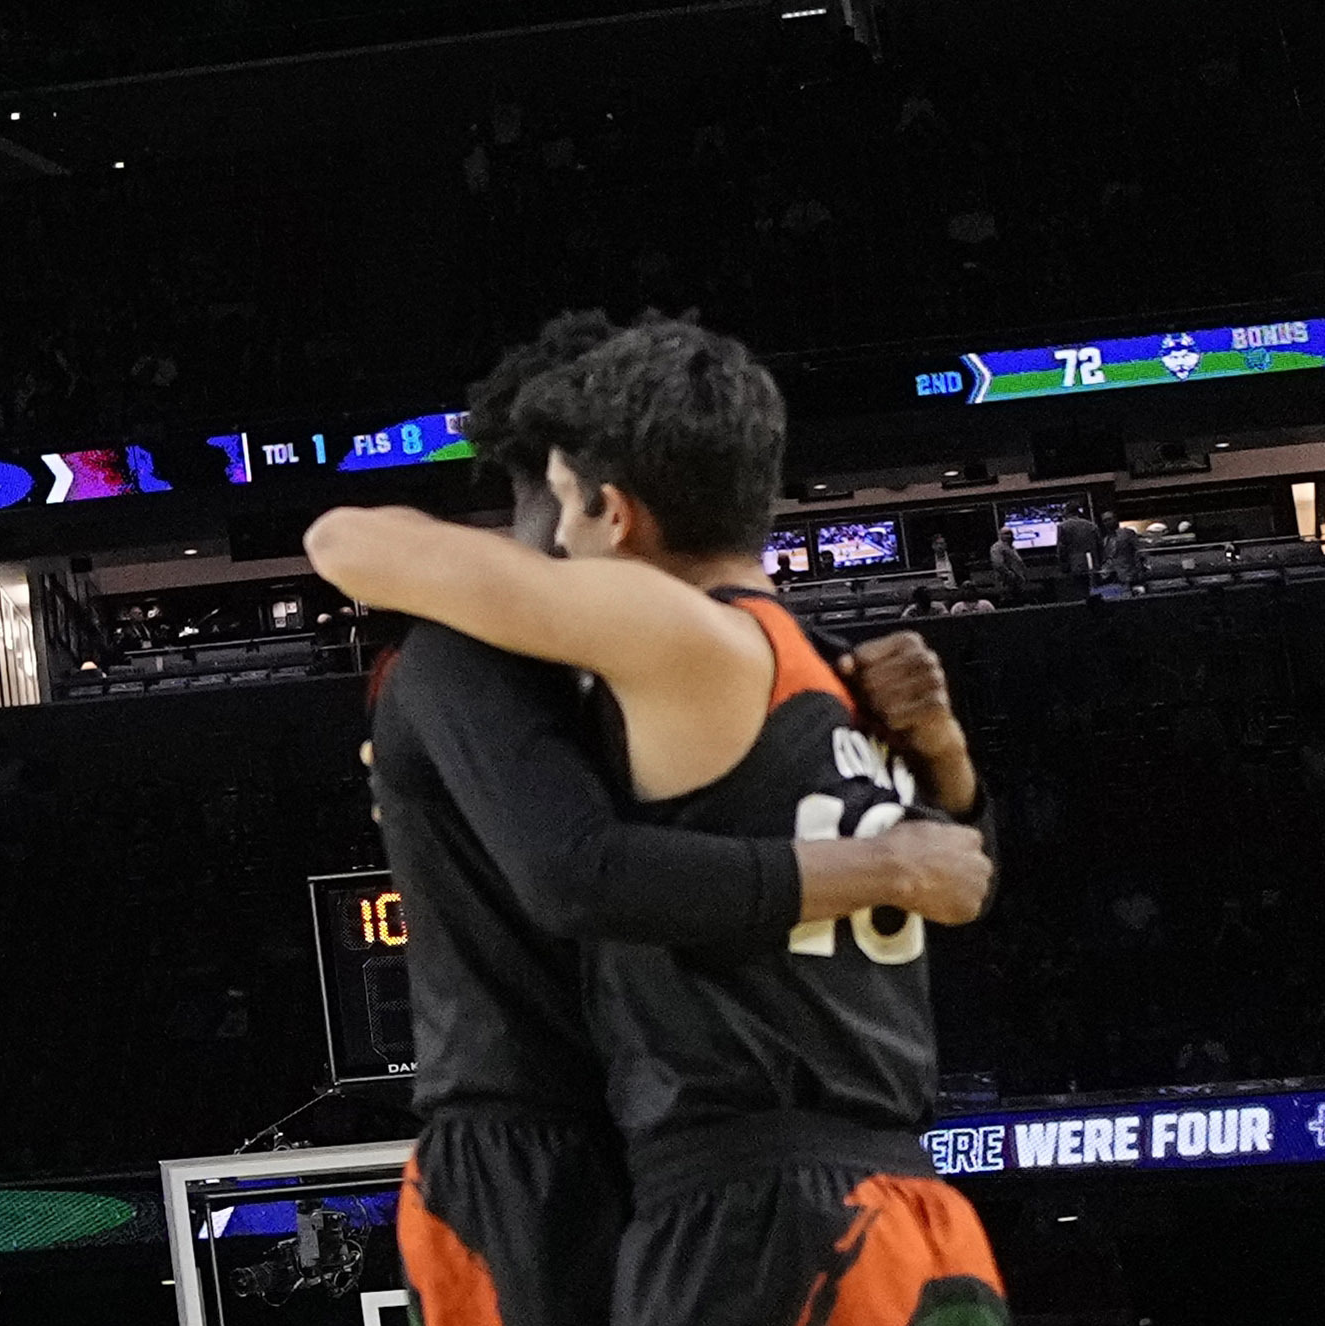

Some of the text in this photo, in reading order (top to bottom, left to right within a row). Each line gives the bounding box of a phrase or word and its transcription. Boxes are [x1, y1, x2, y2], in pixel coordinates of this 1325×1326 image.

[1231, 321, 1309, 350] BONUS
[1054, 347, 1106, 387] 72
[311, 433, 326, 464] 1
[353, 424, 423, 456] FLS 8
[920, 1107, 1273, 1175] ERE WERE FOUR
